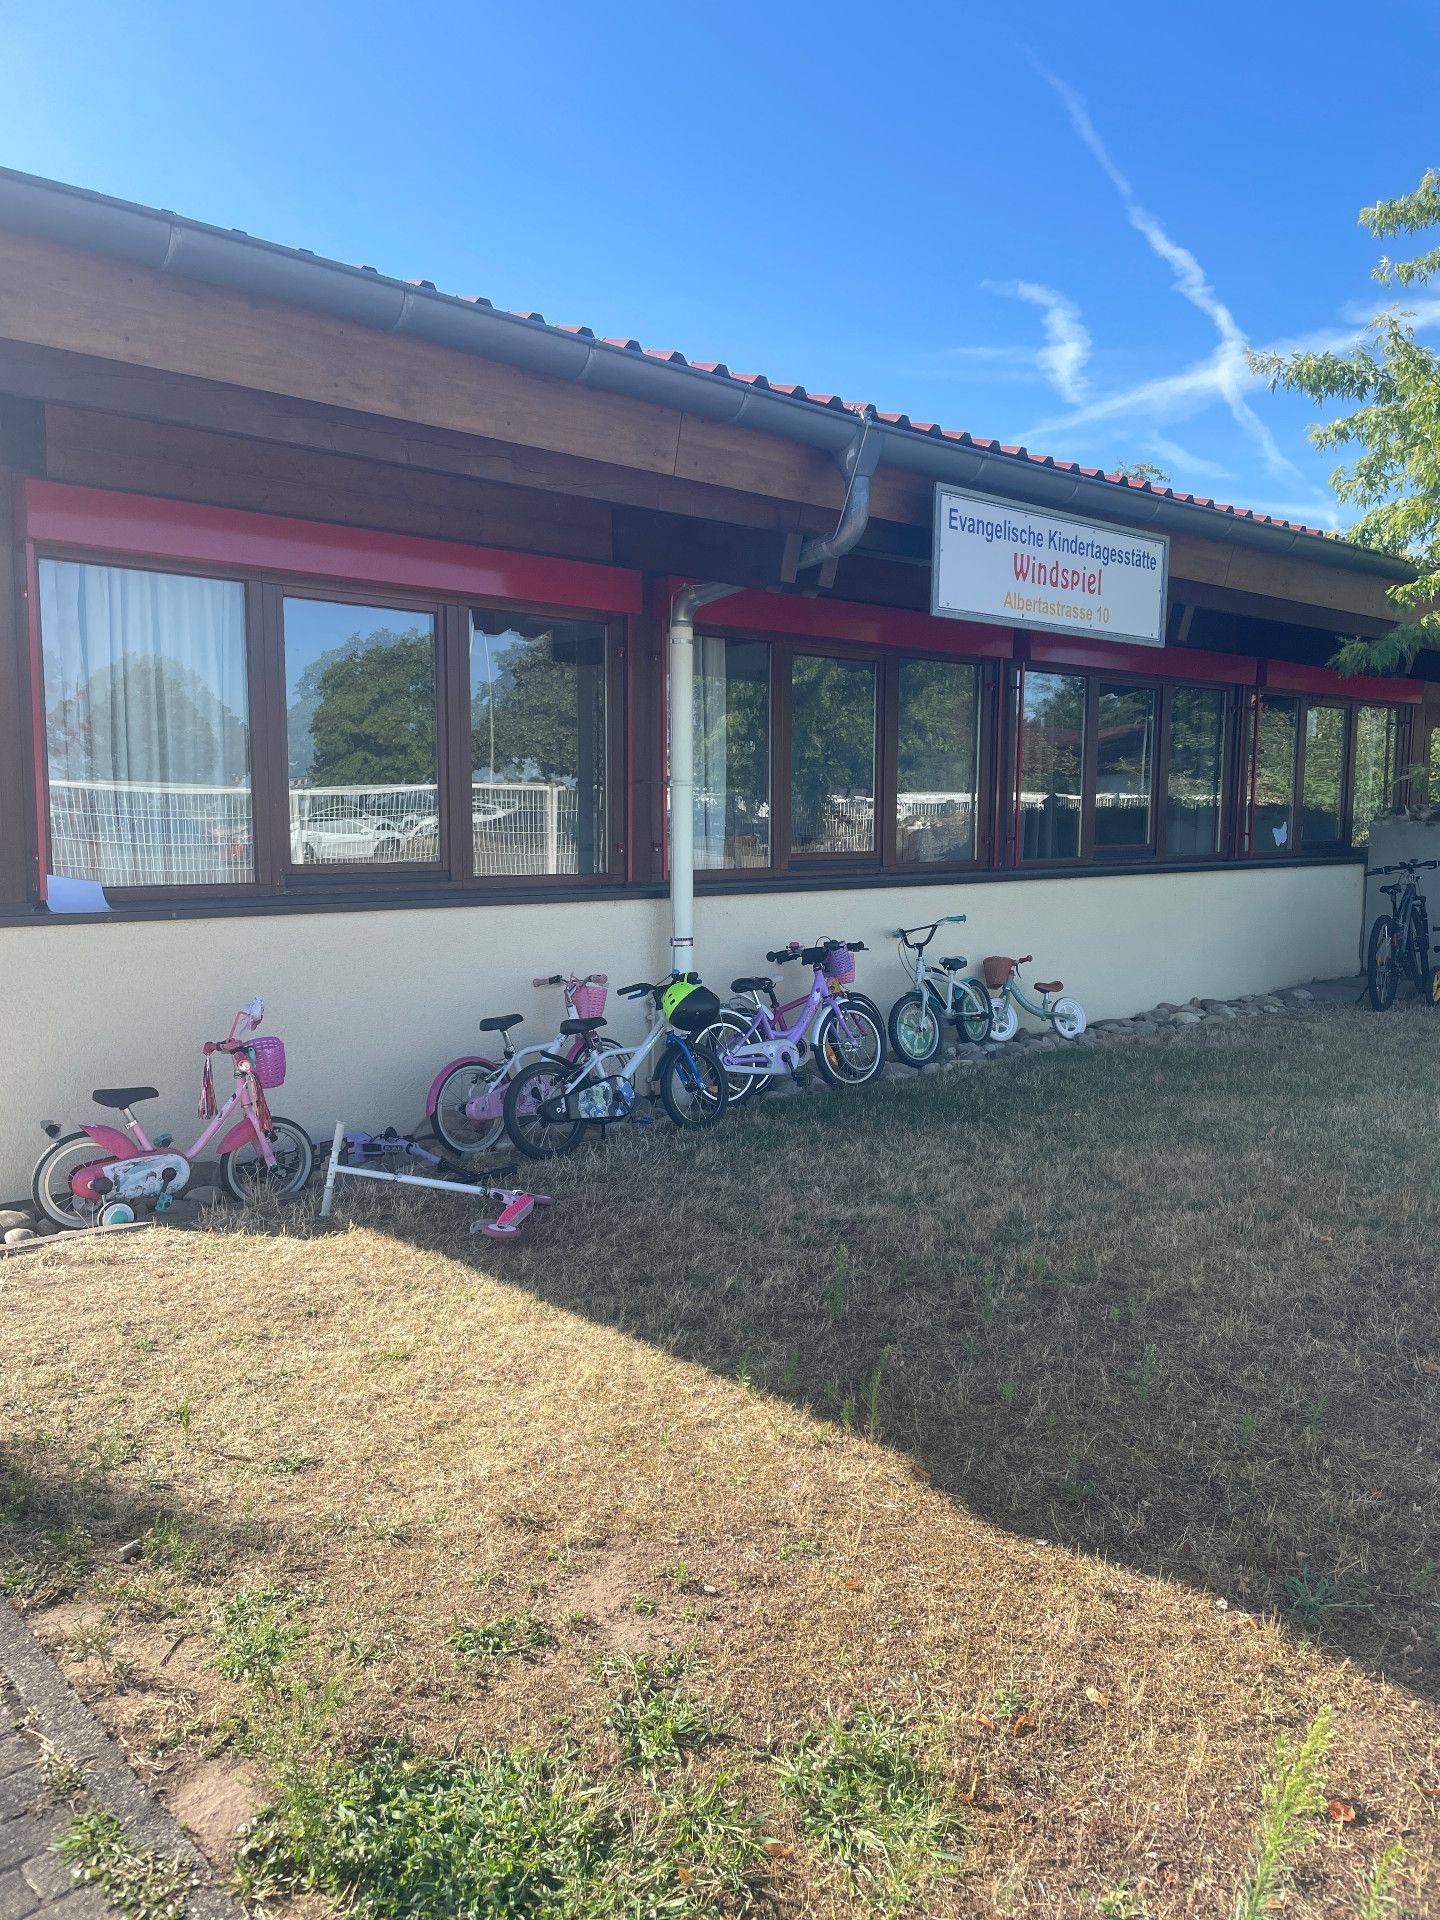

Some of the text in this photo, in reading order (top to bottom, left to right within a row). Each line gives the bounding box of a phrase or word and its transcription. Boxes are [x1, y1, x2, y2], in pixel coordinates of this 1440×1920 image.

[948, 507, 1157, 571] Evangelische Kindertagesstätte
[1013, 552, 1103, 595] Windspiel
[1004, 591, 1110, 624] Albertastrasse 10
